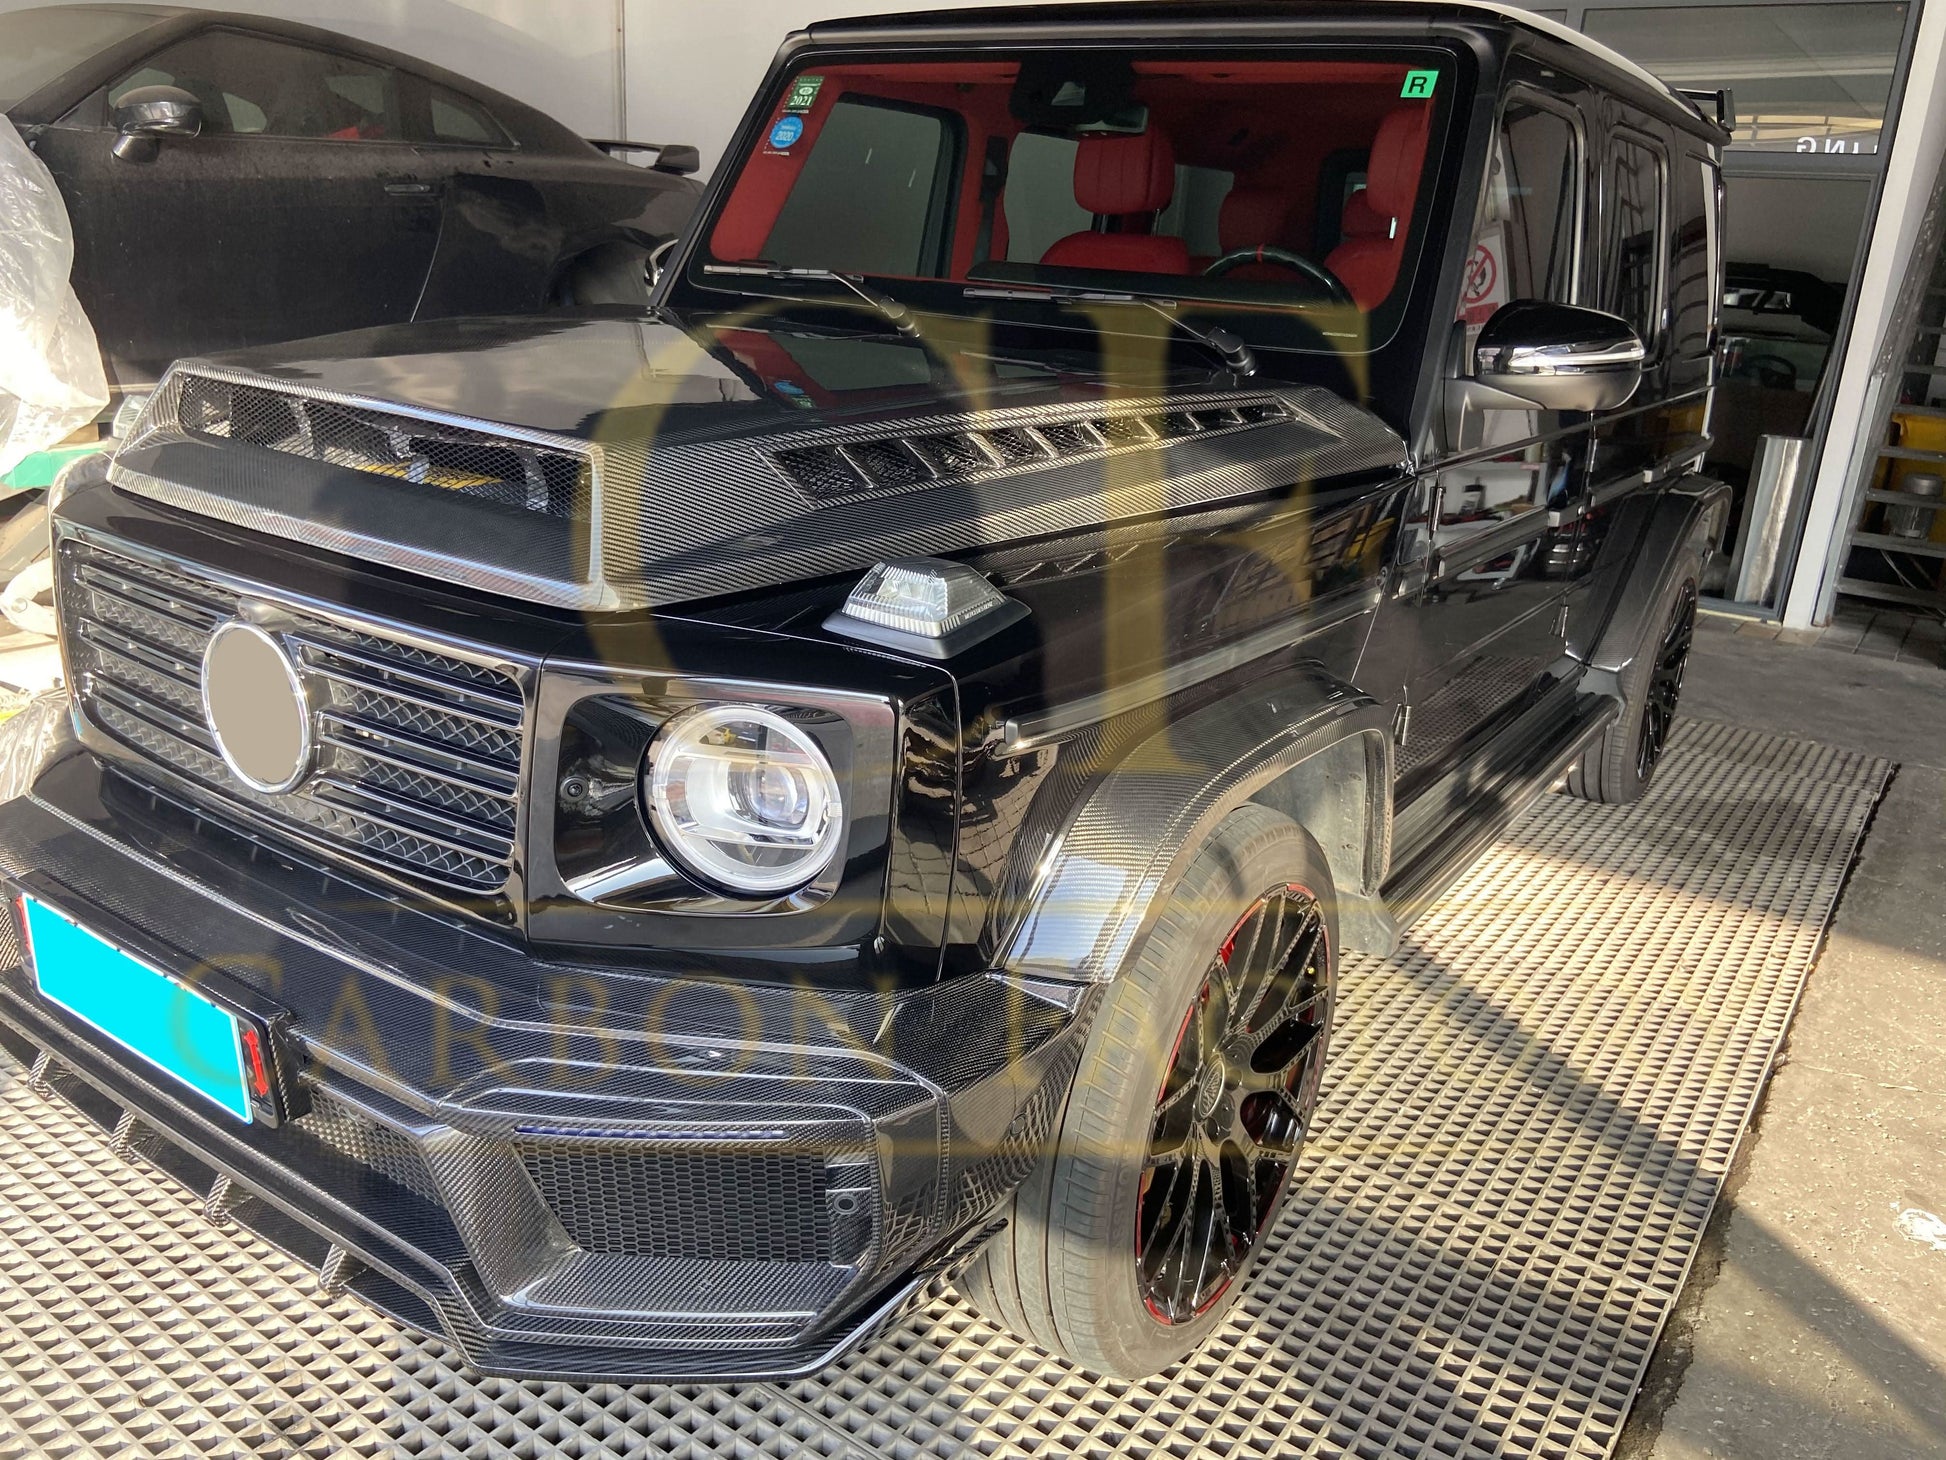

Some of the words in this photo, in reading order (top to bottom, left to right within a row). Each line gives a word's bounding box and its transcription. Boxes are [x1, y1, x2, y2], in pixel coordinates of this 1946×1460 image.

[1408, 76, 1427, 94] R
[789, 95, 813, 106] 2021
[775, 130, 794, 142] 2020
